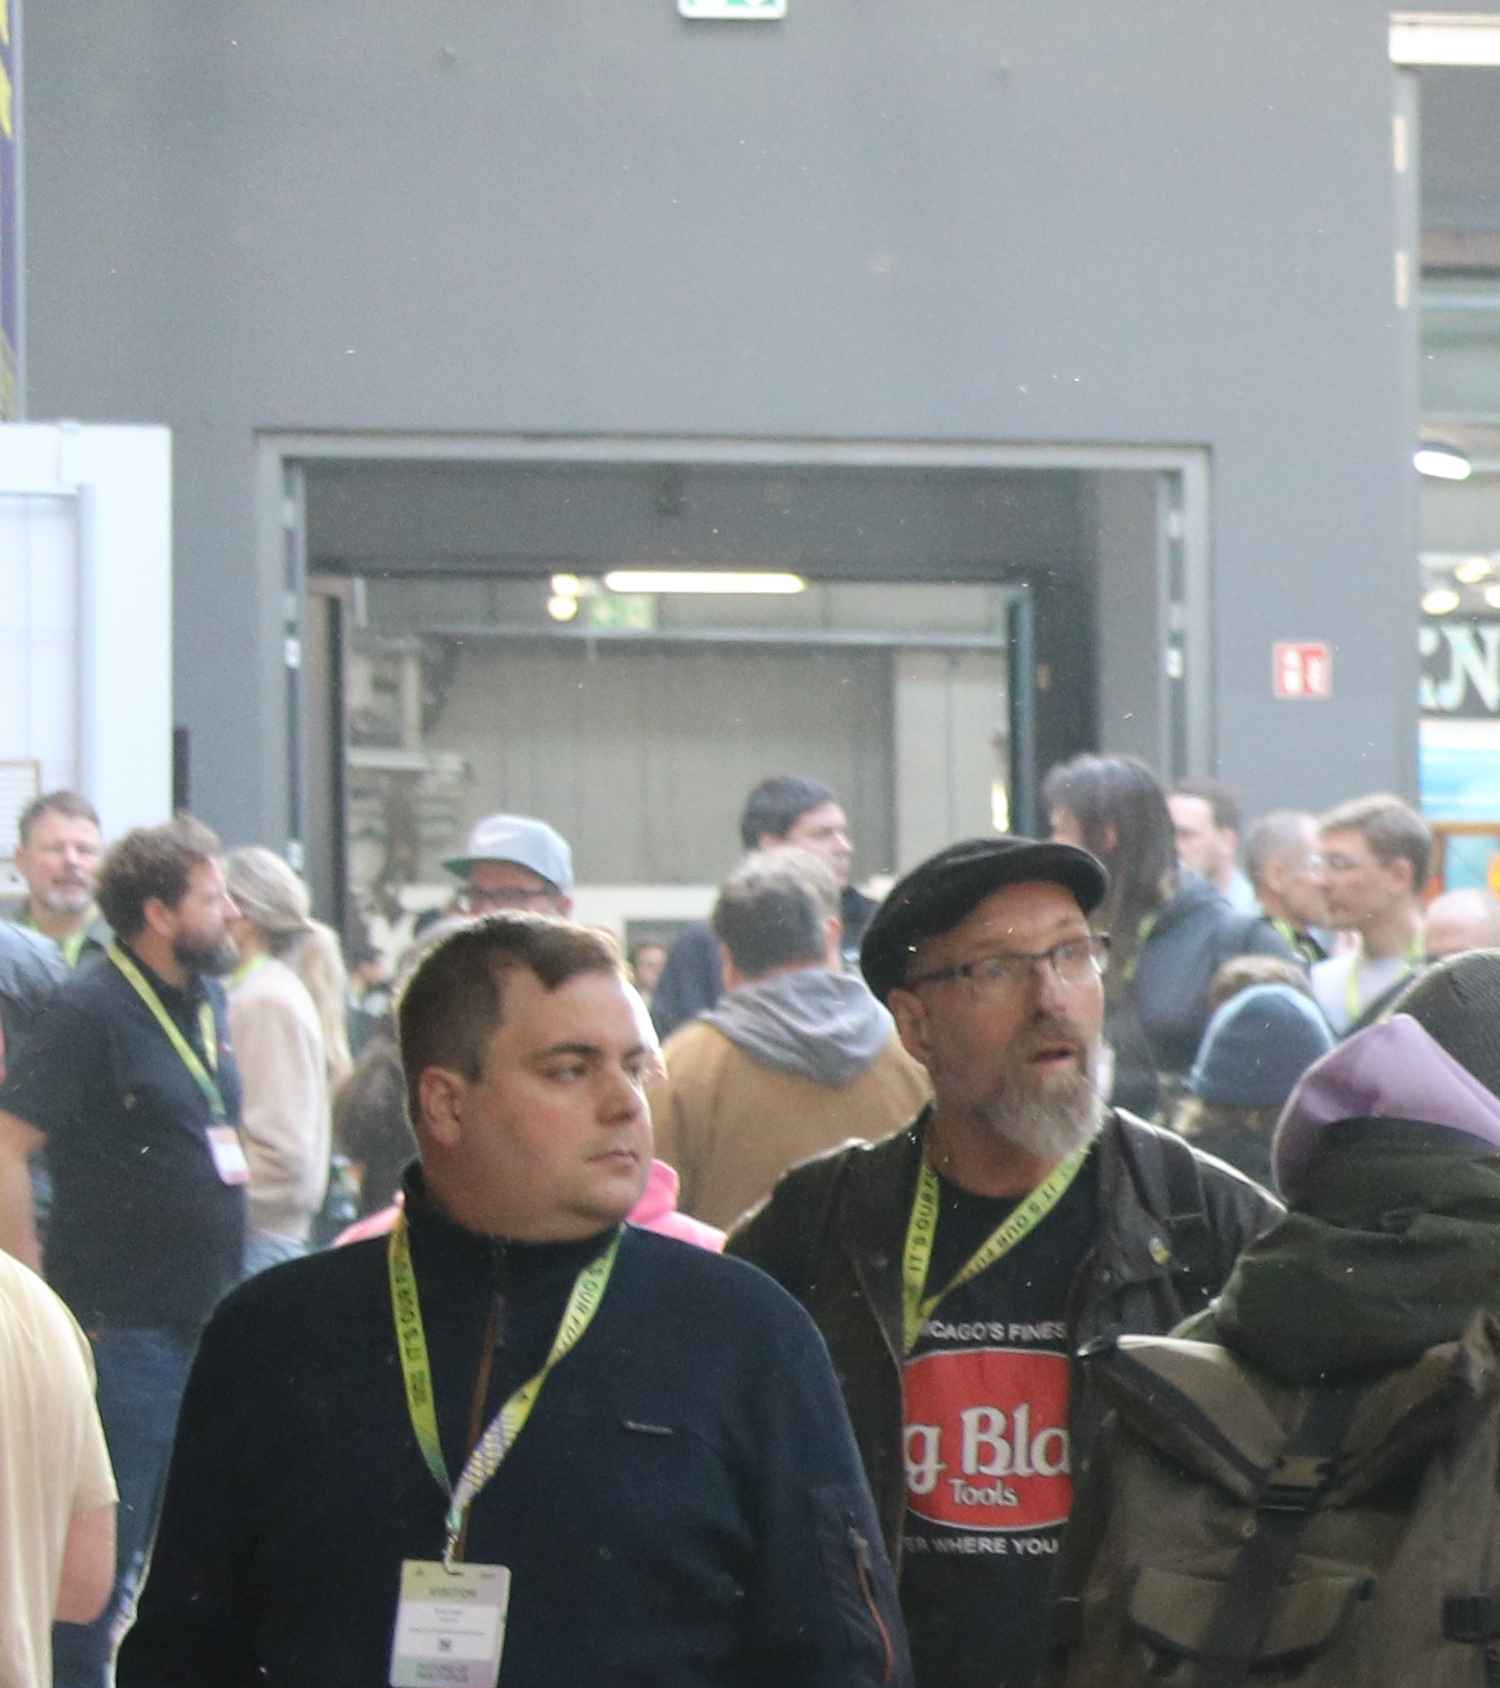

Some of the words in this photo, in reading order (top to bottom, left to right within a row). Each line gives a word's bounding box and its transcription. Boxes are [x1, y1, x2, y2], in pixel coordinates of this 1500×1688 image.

[1007, 1321, 1067, 1341] FINES
[948, 1478, 1019, 1506] Tools
[931, 1537, 1008, 1554] WHERE
[1011, 1538, 1060, 1555] YOU
